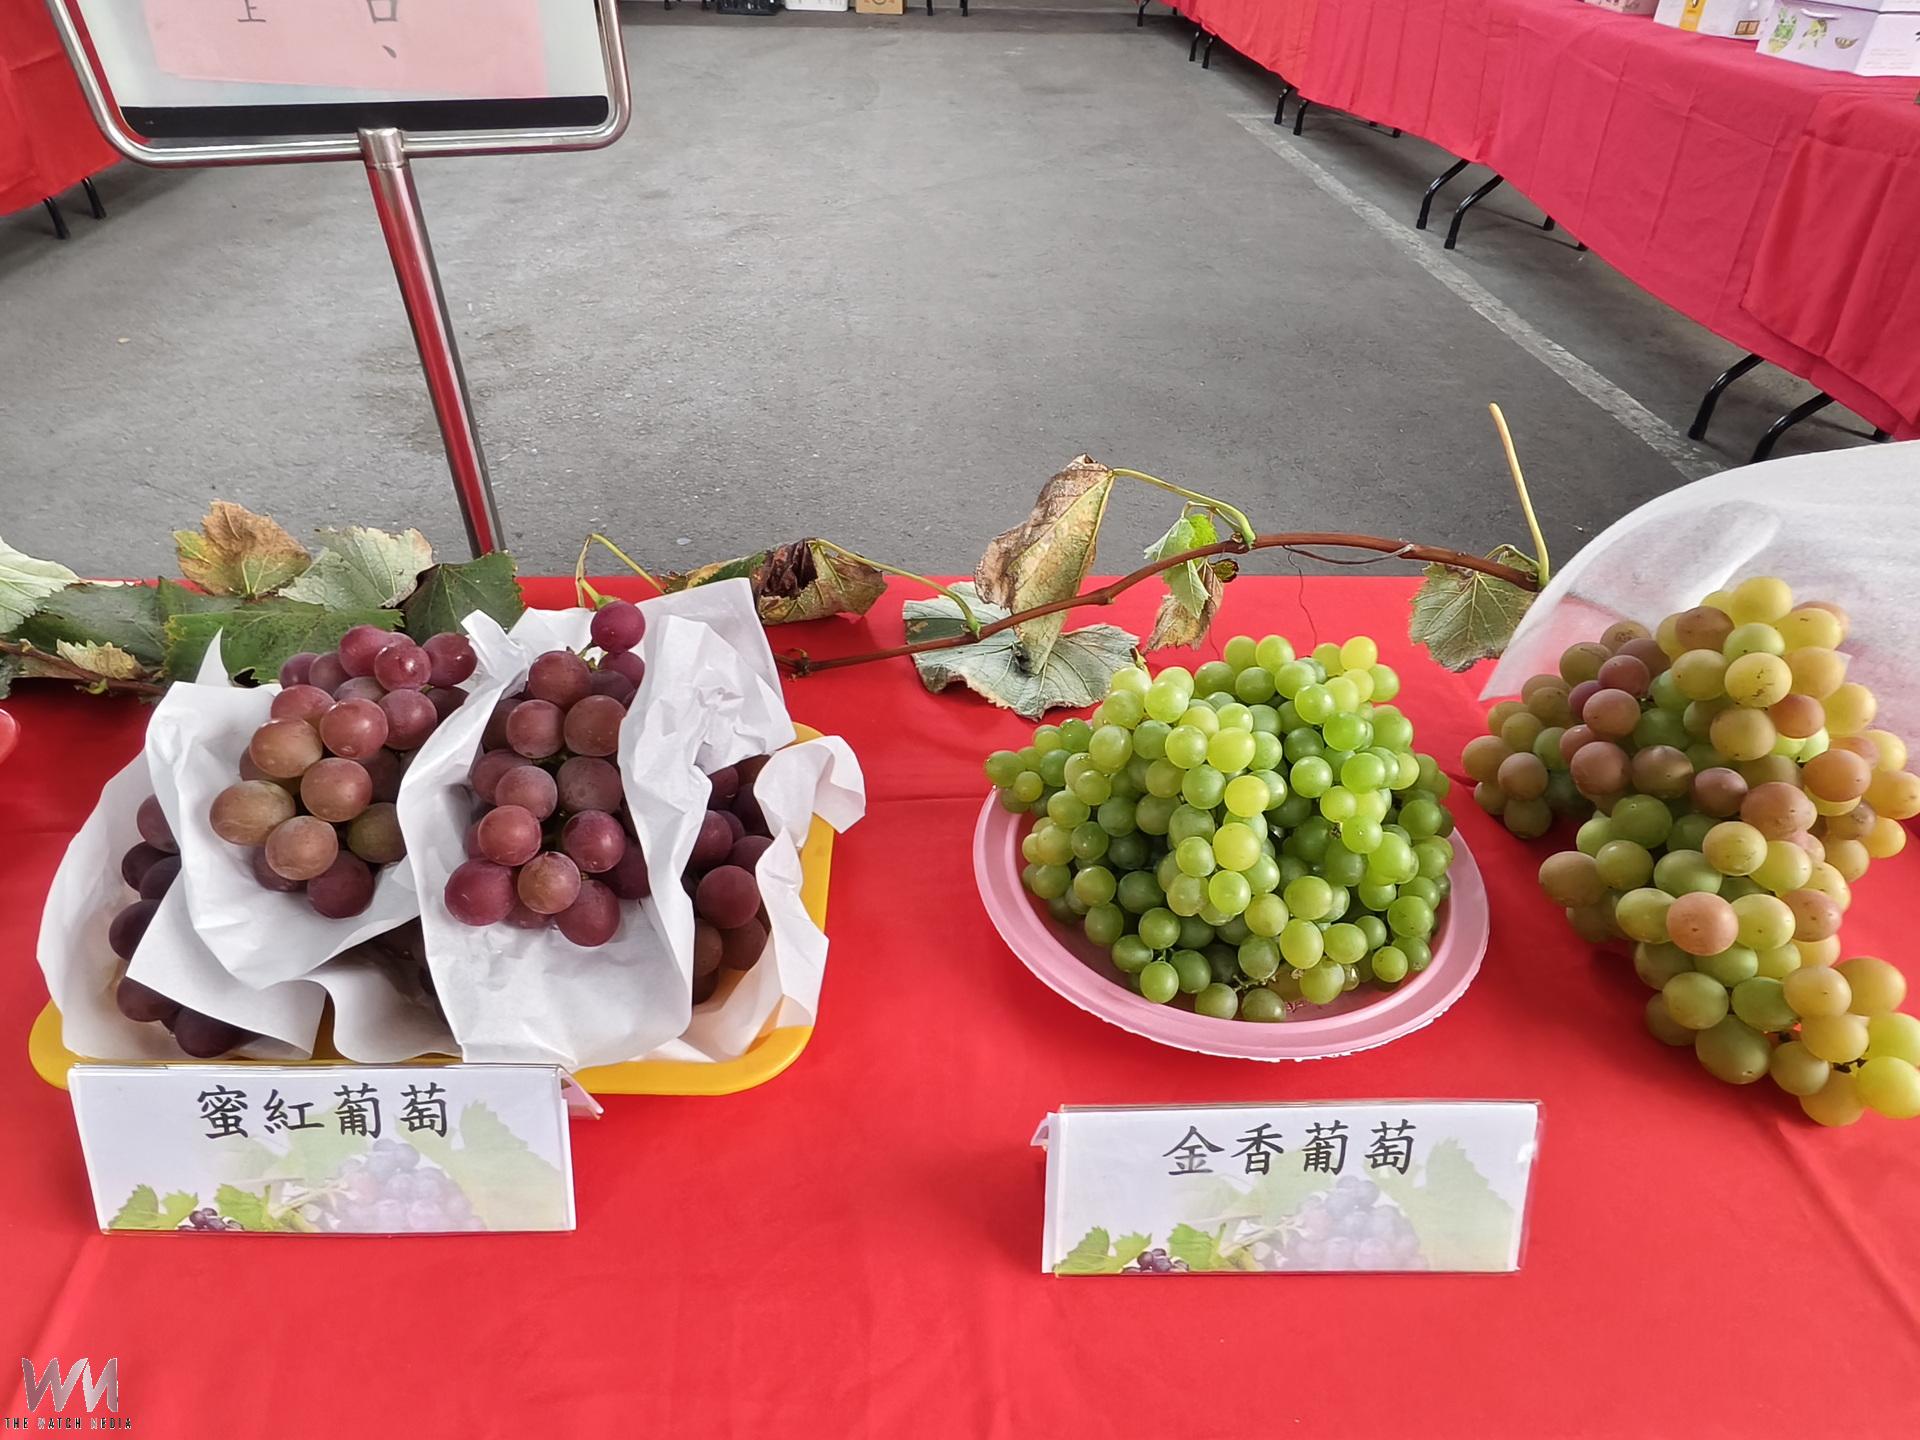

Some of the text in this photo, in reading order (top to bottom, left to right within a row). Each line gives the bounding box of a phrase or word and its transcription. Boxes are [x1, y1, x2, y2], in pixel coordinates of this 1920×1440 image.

[197, 1082, 448, 1139] 蜜紅葡萄
[1162, 1118, 1416, 1176] 金香葡萄
